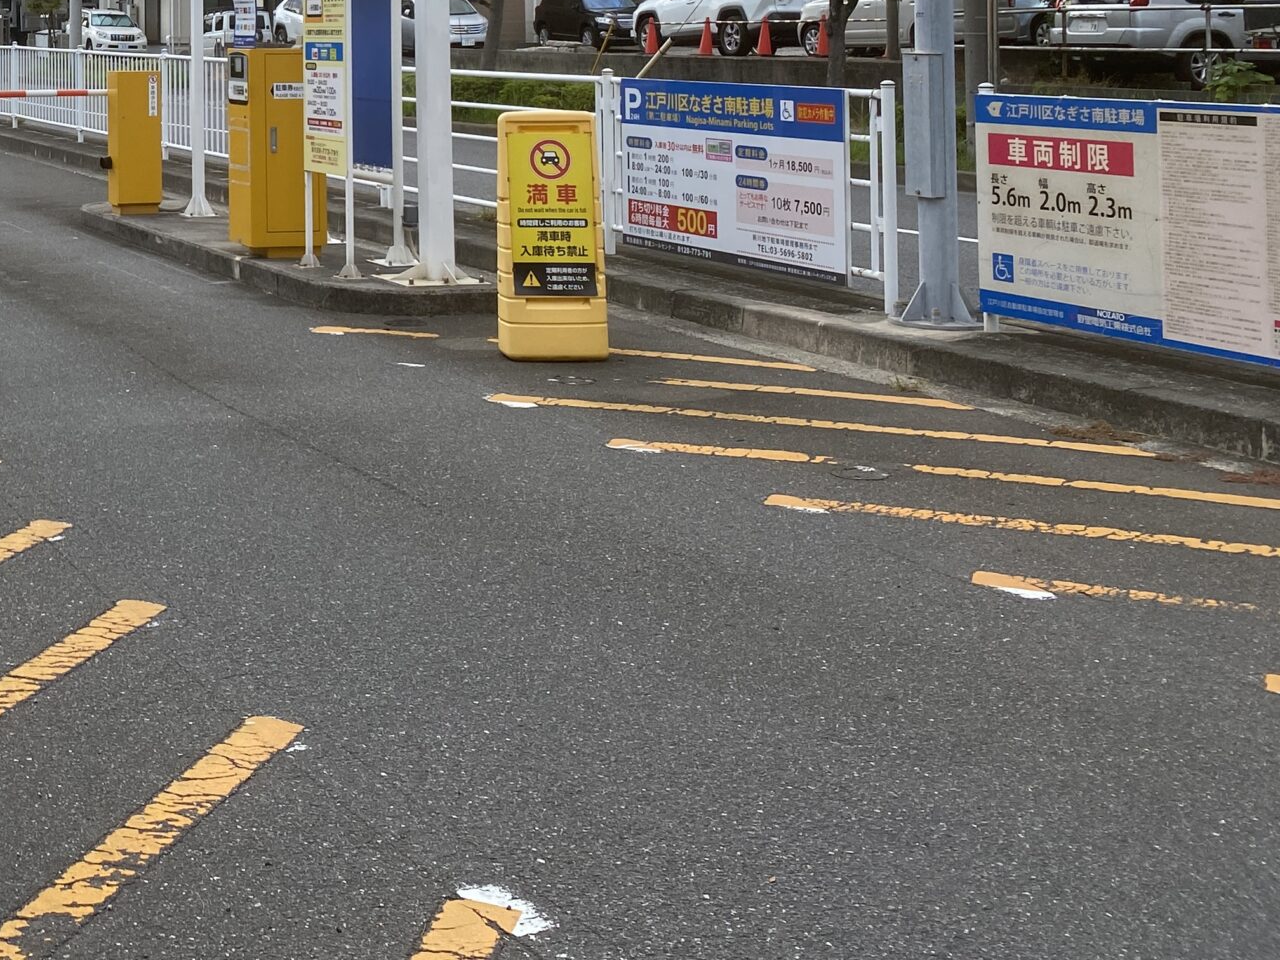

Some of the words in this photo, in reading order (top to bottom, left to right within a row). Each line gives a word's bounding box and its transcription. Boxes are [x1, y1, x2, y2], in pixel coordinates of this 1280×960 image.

[624, 87, 642, 120] P
[645, 91, 775, 118] 江戸川区なぎさ南駐車場
[1005, 102, 1145, 127] 江戸川区なぎさ南駐車場
[733, 119, 758, 131] Parking
[759, 121, 774, 130] Lots
[1007, 137, 1110, 172] 車両制限
[526, 183, 578, 205] 満車
[991, 172, 1009, 185] 長さ
[1038, 177, 1049, 189] 幅
[1086, 182, 1107, 195] 高さ
[631, 201, 670, 218] 打ち切り料金
[771, 197, 792, 212] 10枚
[794, 199, 830, 218] 7,500円
[991, 186, 1031, 209] 5.6m
[1039, 190, 1081, 214] 2.0m
[1088, 195, 1133, 220] 2.3m
[631, 213, 670, 229] 6時間毎最大
[537, 230, 571, 242] 満車時
[520, 245, 589, 257] 入庫待ち禁止
